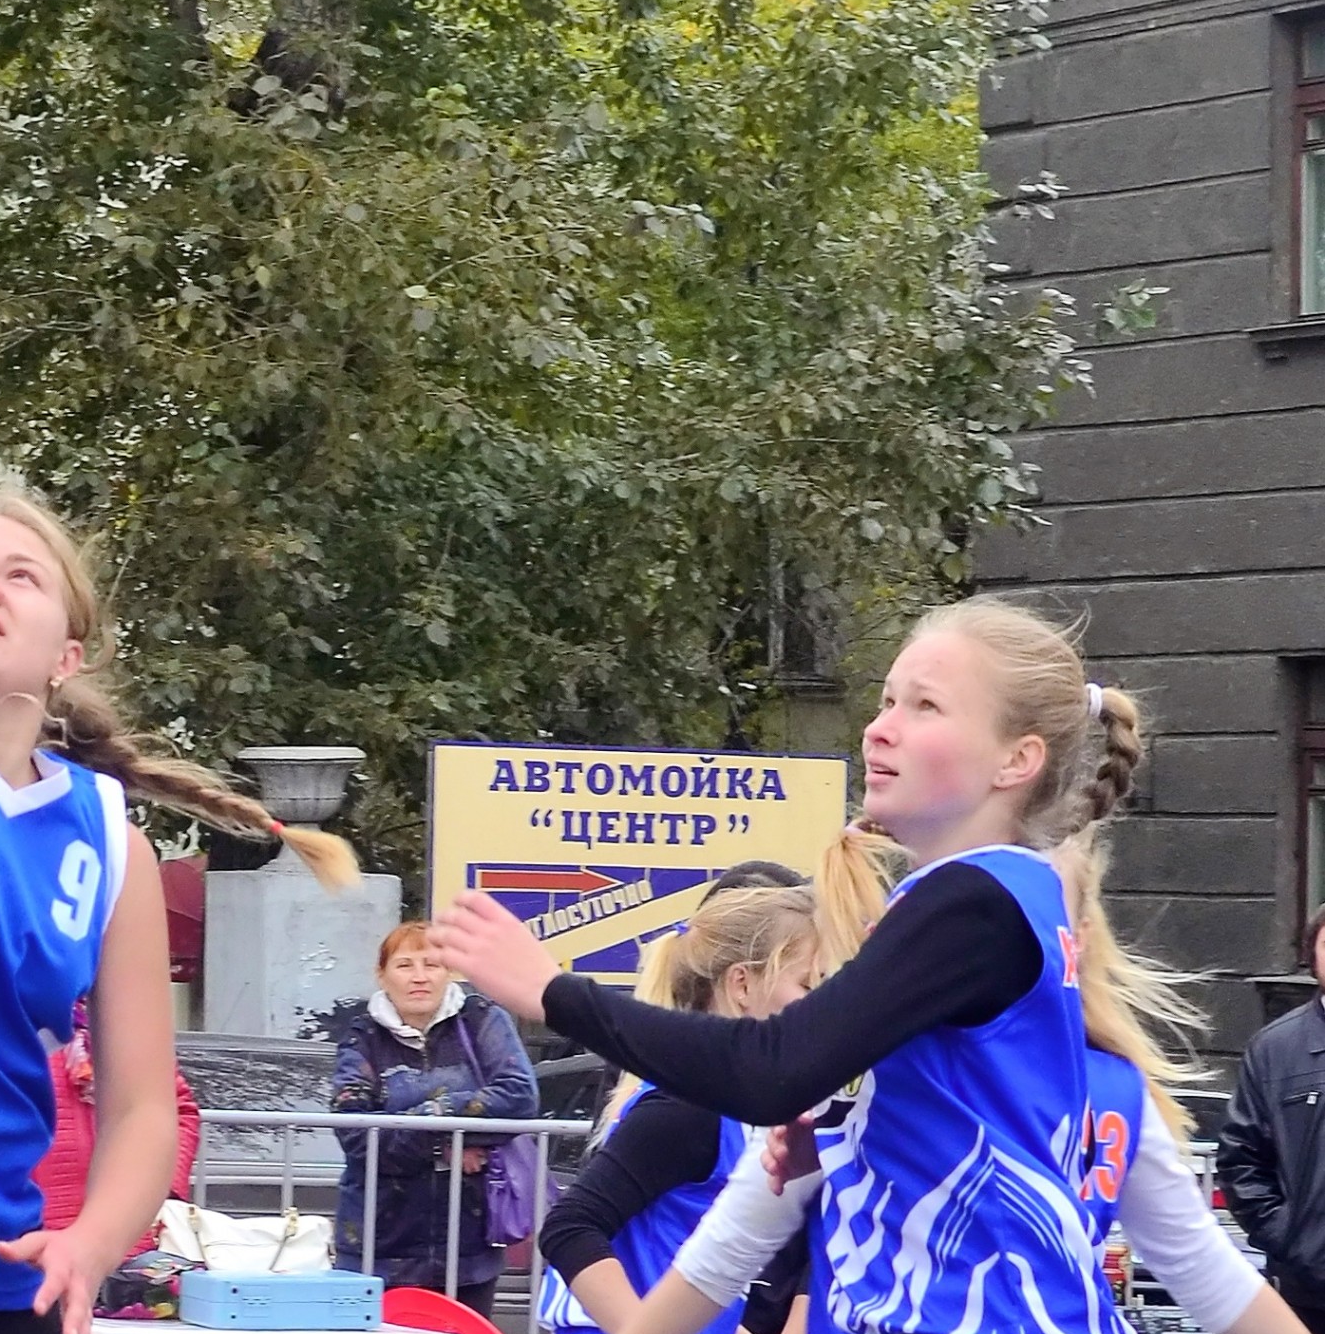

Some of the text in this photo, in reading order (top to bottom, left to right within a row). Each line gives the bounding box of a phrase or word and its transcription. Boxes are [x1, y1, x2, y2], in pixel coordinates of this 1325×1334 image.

[488, 756, 786, 801] АВТОМОЙКА
[51, 839, 102, 942] 9
[524, 879, 653, 941] ГЛОСУТОЧНО
